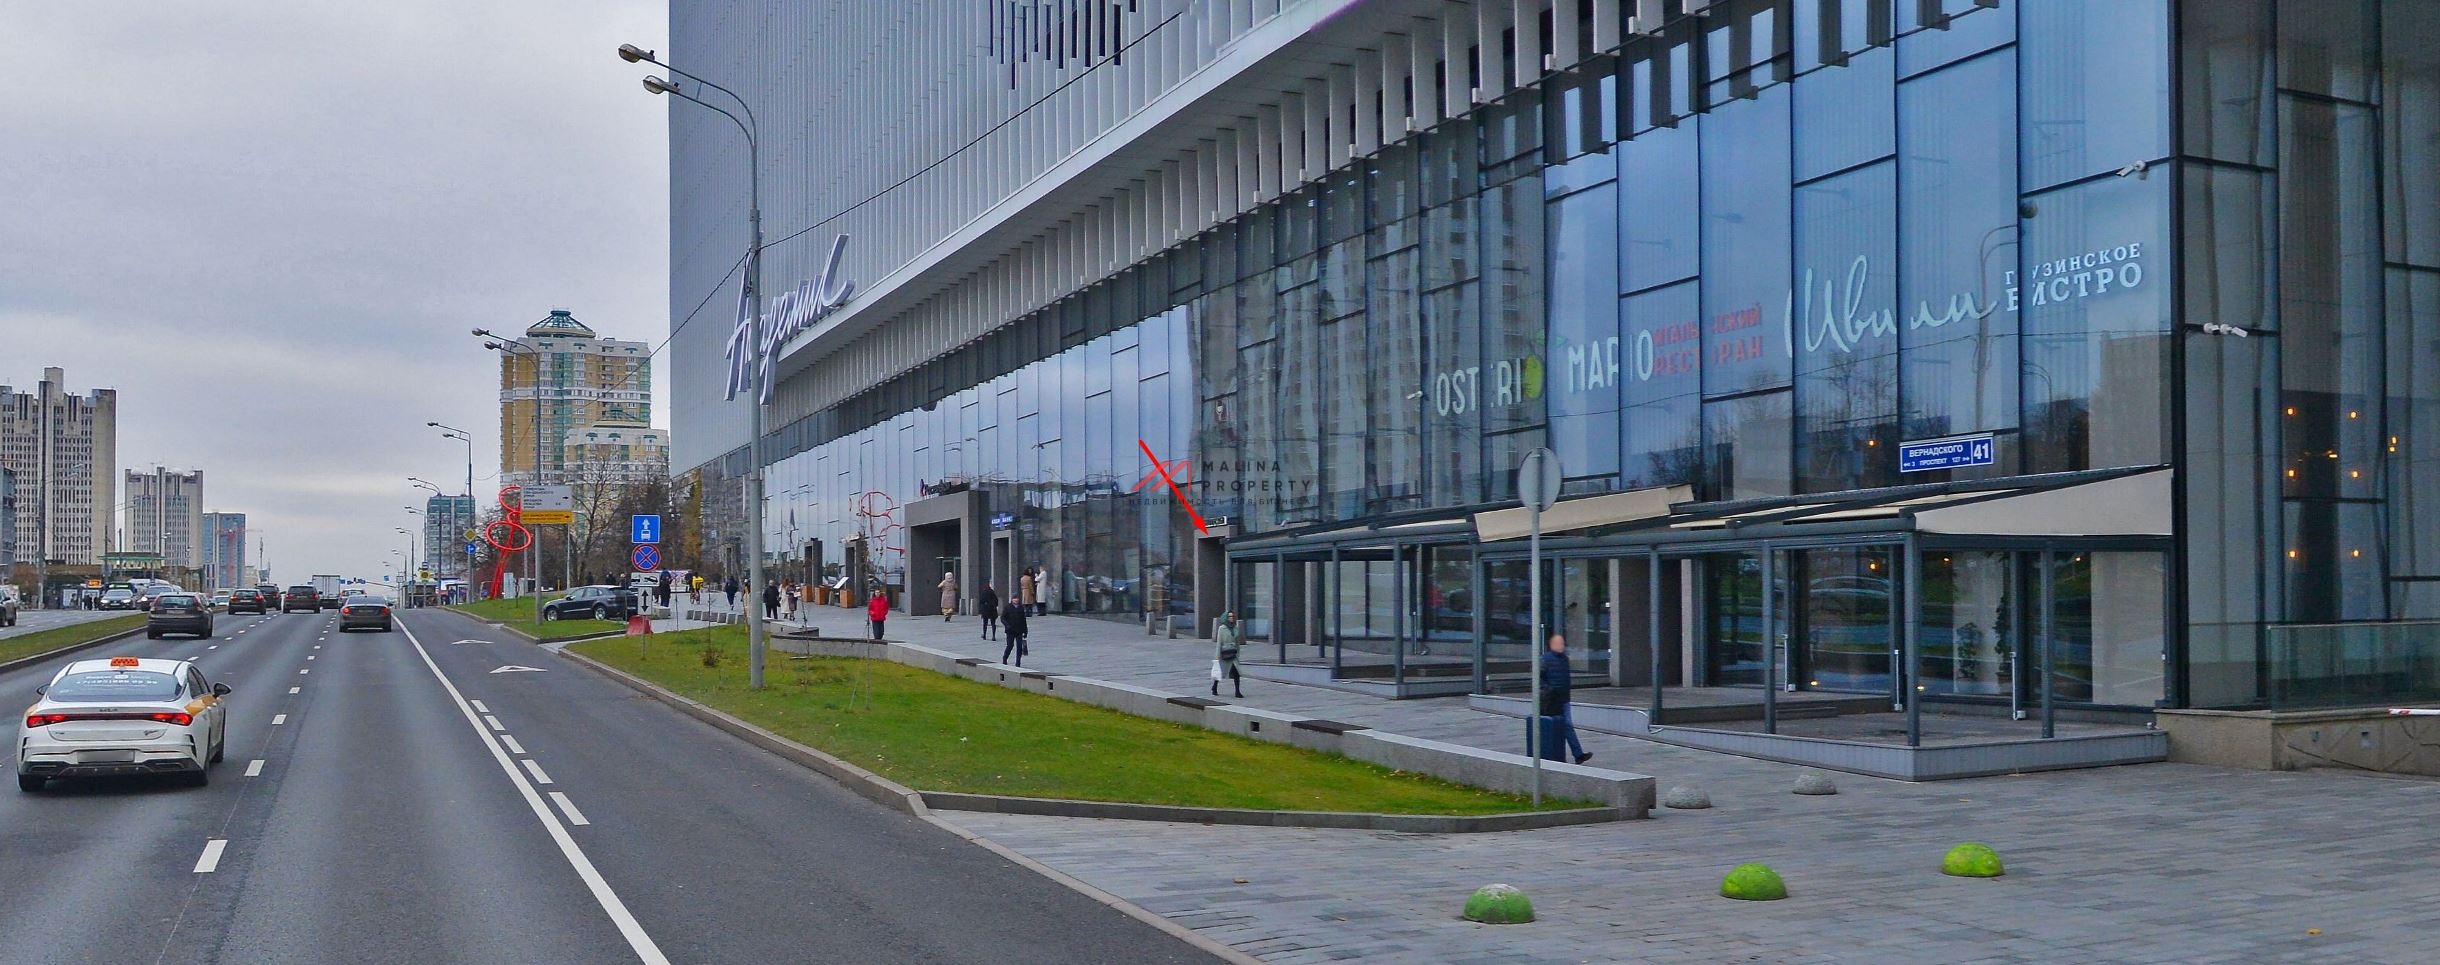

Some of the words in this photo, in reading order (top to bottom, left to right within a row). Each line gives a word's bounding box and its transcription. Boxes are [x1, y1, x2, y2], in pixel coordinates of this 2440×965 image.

[2004, 242, 2142, 286] ГУЗИНСКОЕ
[1653, 301, 1762, 347] ИТАЛЬСКИЙ
[1909, 444, 1964, 458] ВЕРНАДСКОГО
[1973, 442, 1989, 460] 41
[1919, 457, 1947, 466] ПРОСПЕКТ
